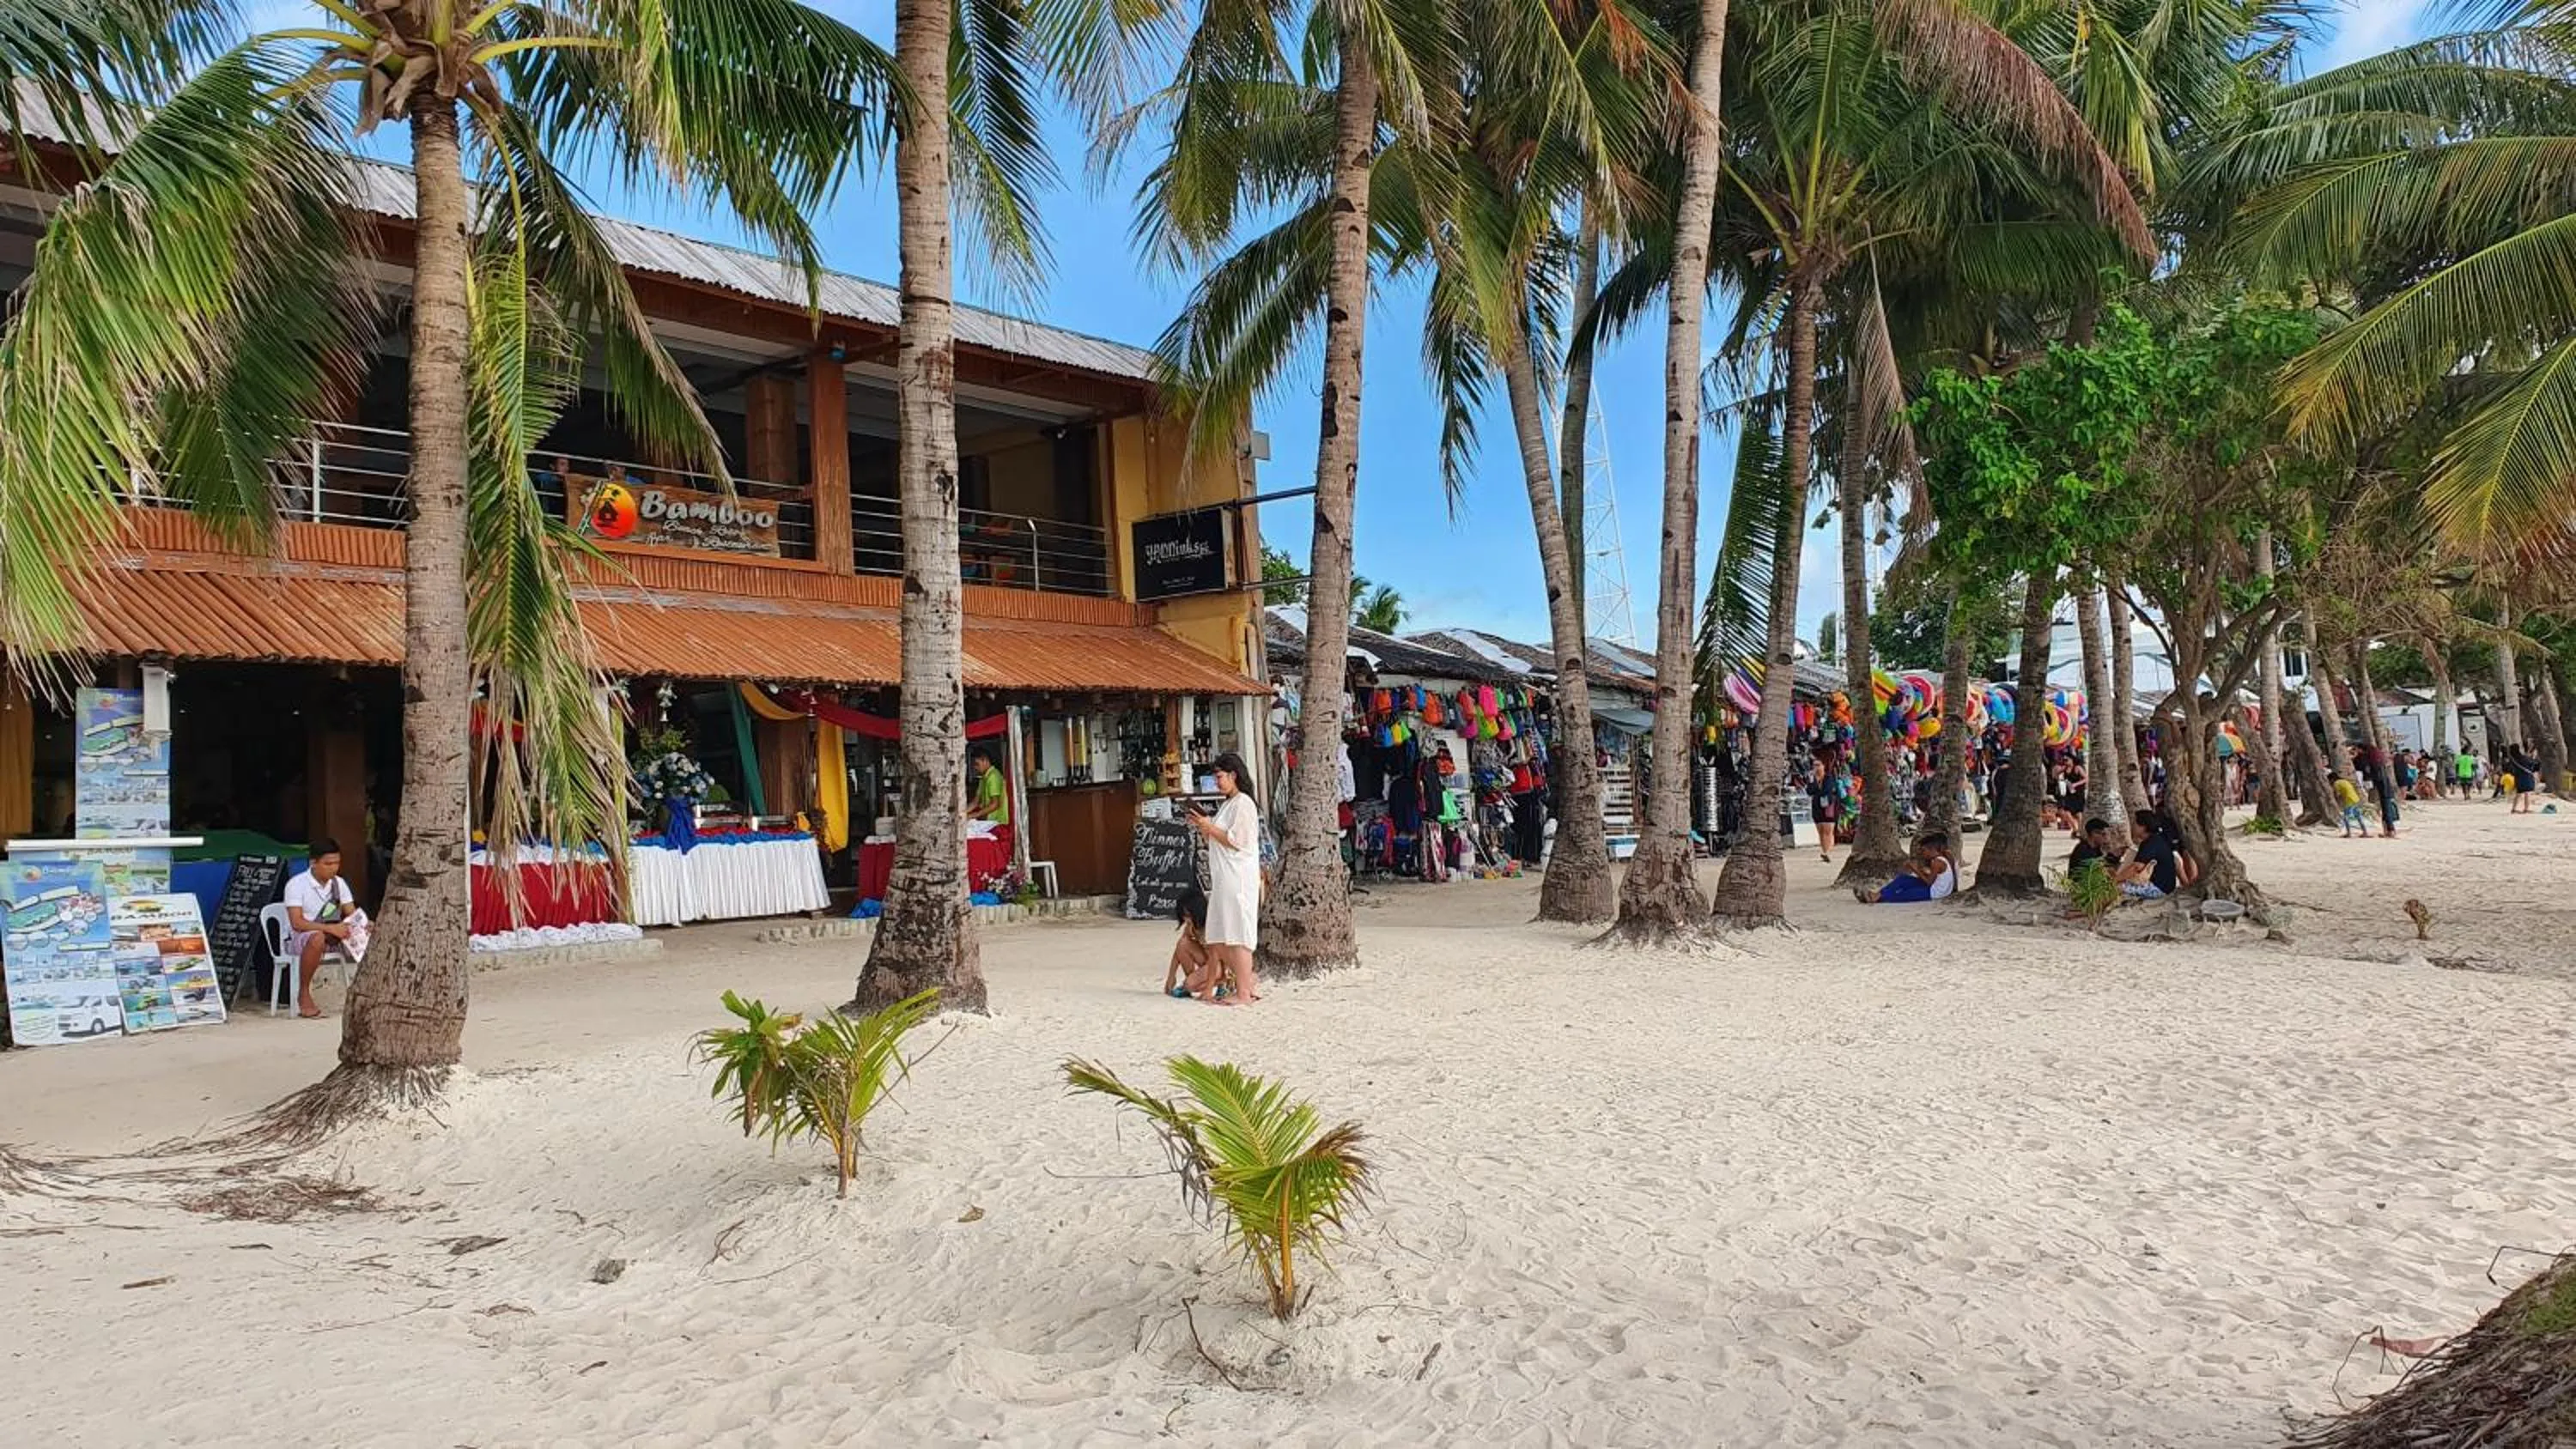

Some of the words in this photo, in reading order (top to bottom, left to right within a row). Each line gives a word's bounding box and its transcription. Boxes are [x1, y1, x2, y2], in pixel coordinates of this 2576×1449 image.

[641, 491, 774, 527] Bamboo
[1133, 823, 1187, 846] Dinner
[1134, 846, 1184, 873] Buffet
